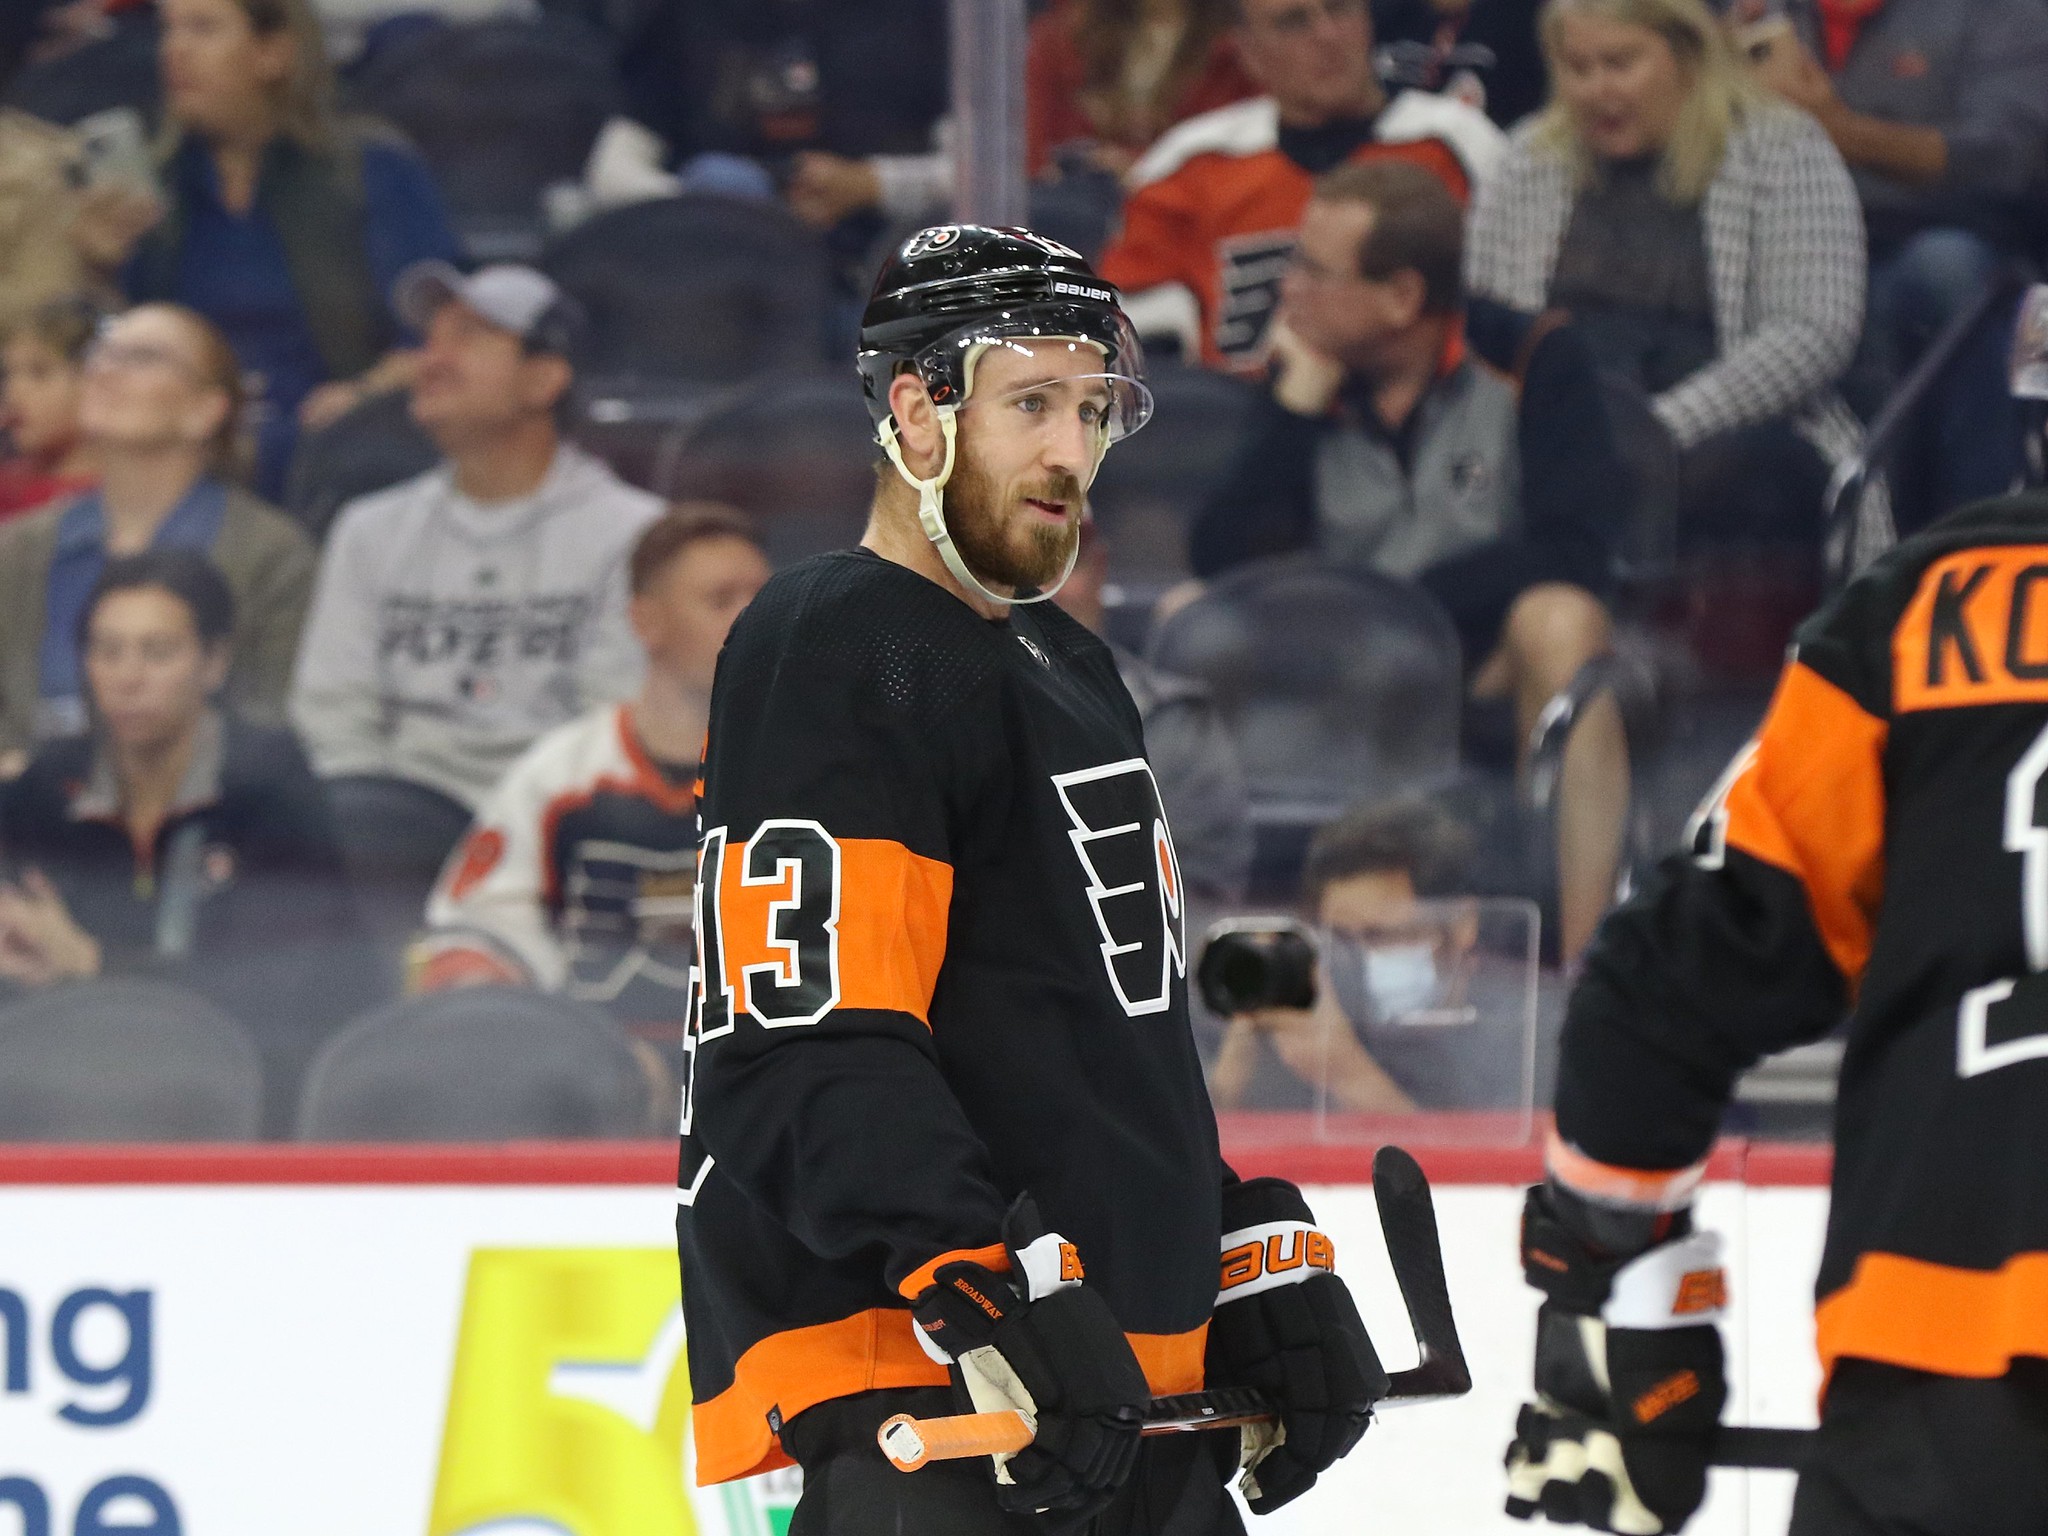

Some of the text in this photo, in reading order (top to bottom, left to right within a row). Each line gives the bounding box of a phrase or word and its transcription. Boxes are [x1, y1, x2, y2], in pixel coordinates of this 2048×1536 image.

[1054, 281, 1112, 303] BAUER
[696, 818, 842, 1045] 13
[1220, 1229, 1335, 1292] AUE
[952, 1276, 1004, 1321] BROADWAY
